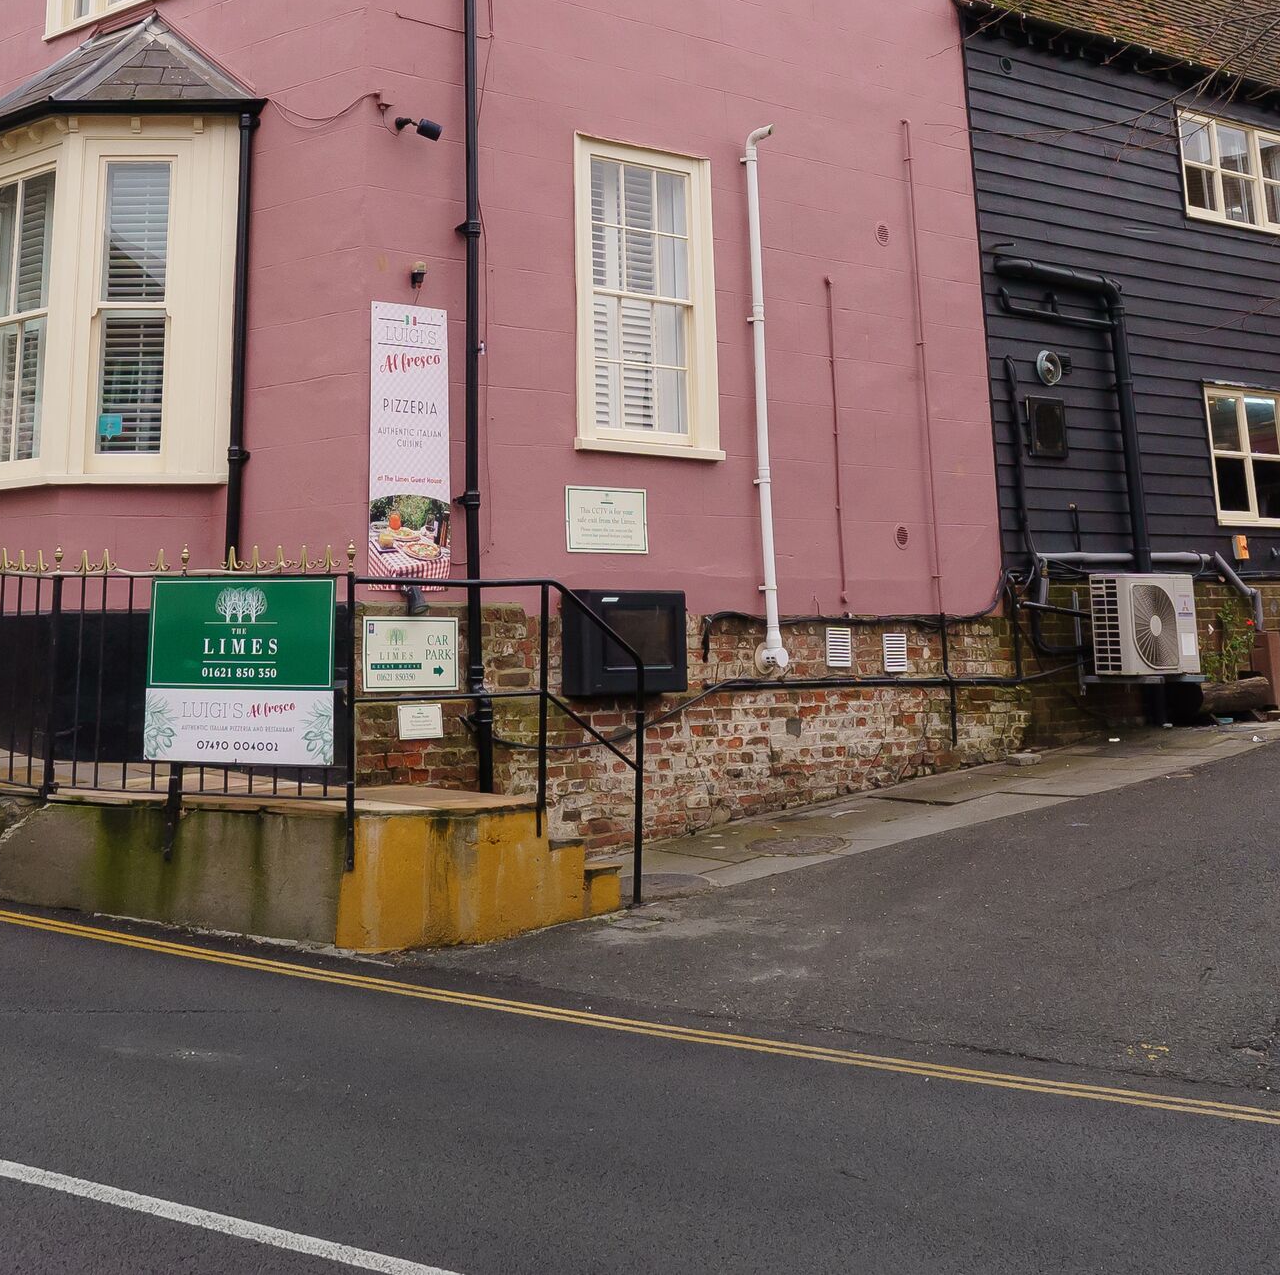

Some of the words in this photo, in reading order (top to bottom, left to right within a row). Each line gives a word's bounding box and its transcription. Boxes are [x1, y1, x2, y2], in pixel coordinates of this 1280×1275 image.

[380, 353, 398, 373] Al
[401, 353, 441, 373] fresco
[383, 398, 437, 415] PIZZERIA
[378, 427, 415, 436] AUTHENTIC
[416, 429, 442, 438] ITALIAN
[397, 439, 423, 448] CUISINE
[427, 634, 449, 646] CAR
[203, 638, 278, 655] LIMES
[379, 652, 414, 661] LIMES
[425, 648, 452, 661] PARK
[201, 667, 232, 678] 01621
[235, 667, 255, 678] 850
[258, 668, 277, 678] 350
[181, 701, 243, 719] LUIGI'S
[246, 702, 262, 719] Al
[263, 702, 296, 718] fresco
[197, 740, 229, 750] 07490
[233, 741, 279, 752] 004002
